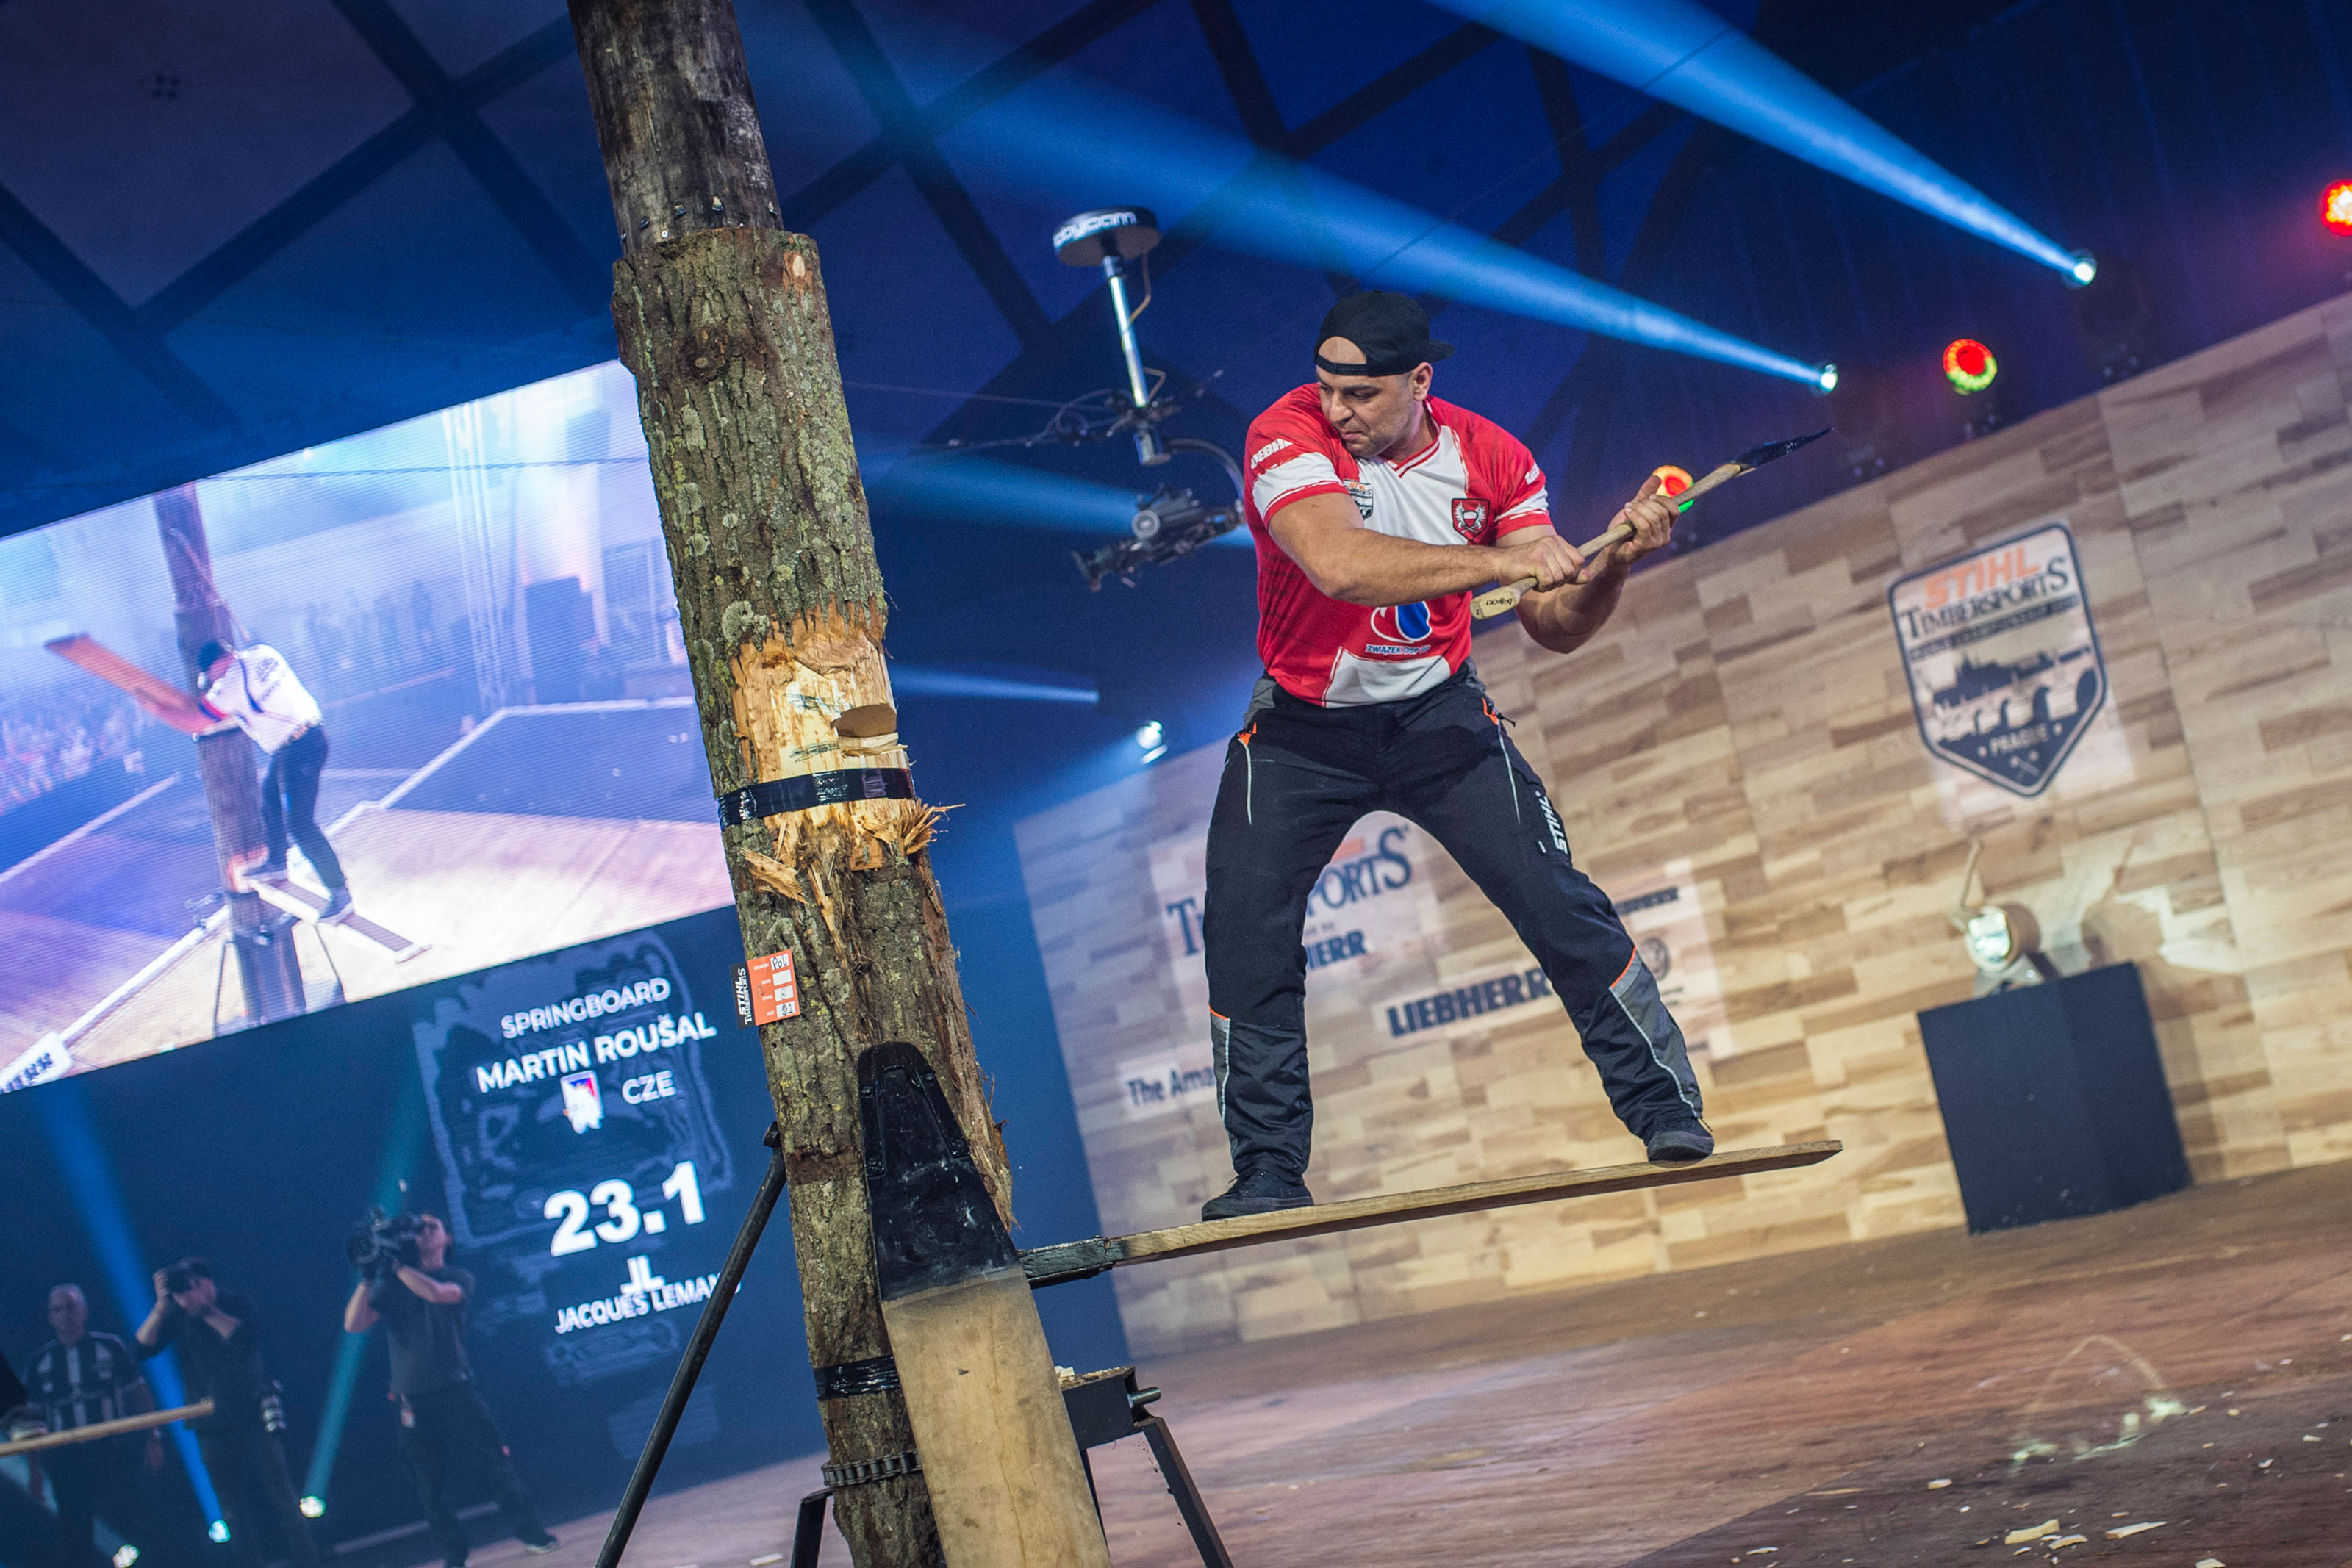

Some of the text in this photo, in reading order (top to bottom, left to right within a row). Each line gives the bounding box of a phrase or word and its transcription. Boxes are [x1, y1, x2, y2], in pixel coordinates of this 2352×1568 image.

[1925, 547, 2040, 610] STIHL
[1402, 645, 1419, 655] OSP
[1538, 796, 1568, 855] STIHL
[501, 977, 671, 1039] SPRINGBOARD
[735, 976, 747, 1016] STIHL
[1388, 967, 1552, 1038] LIEBHERR
[476, 1011, 718, 1093] MARTIN ROUŠAL
[621, 1070, 676, 1104] CZE
[1127, 1077, 1165, 1107] The
[543, 1159, 706, 1257] 23.1
[553, 1272, 742, 1334] JACQUES LEMA
